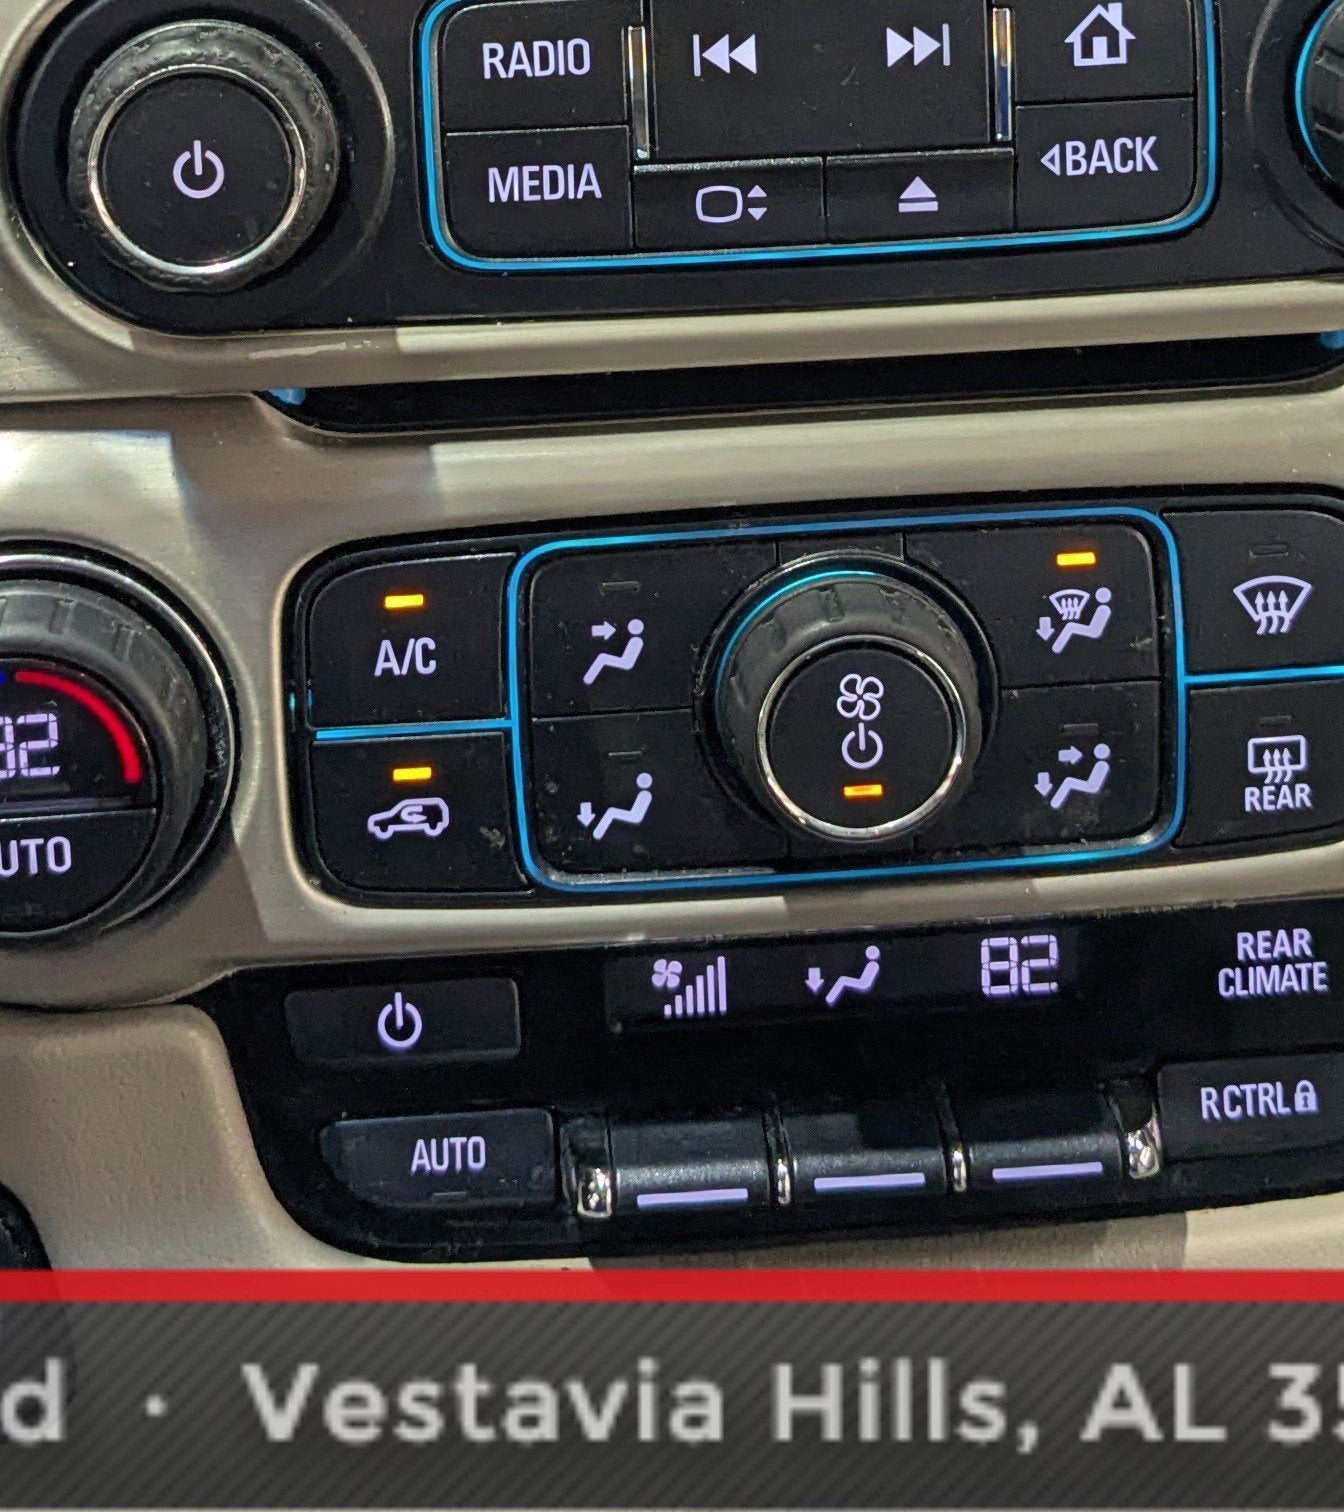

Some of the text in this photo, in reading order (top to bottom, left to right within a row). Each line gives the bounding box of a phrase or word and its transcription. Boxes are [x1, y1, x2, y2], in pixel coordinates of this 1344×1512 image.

[483, 38, 590, 79] RADIO
[1066, 136, 1158, 175] BACK
[489, 164, 602, 202] MEDIA
[375, 637, 436, 676] A/C
[1245, 785, 1312, 812] REAR
[1237, 928, 1312, 960] REAR
[981, 935, 1058, 996] 82
[1218, 961, 1328, 998] CLIMATE
[411, 1136, 485, 1172] AUTO
